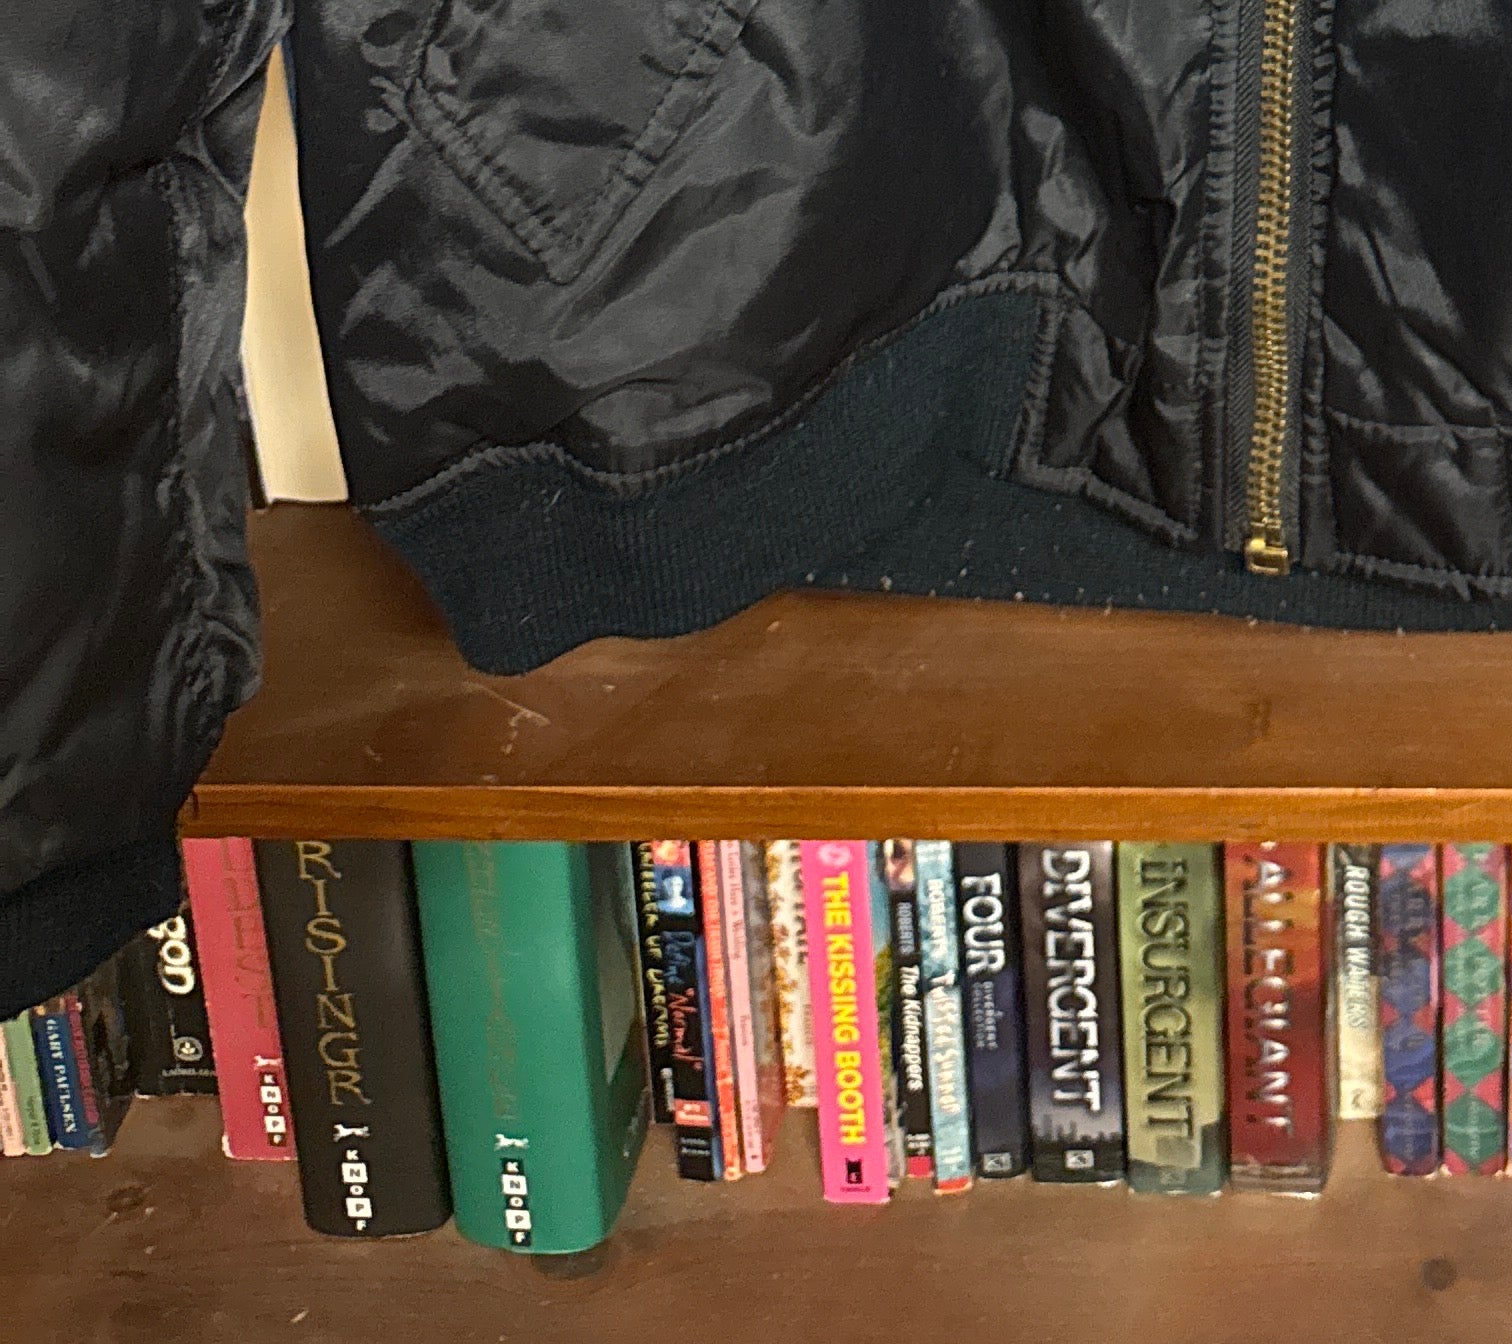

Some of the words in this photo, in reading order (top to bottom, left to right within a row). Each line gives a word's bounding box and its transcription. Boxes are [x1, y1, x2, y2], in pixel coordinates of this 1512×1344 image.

[819, 870, 853, 928] THE
[960, 872, 1006, 975] FOUR
[1344, 863, 1371, 943] ROUGH
[296, 840, 373, 1106] RISINGR
[826, 933, 860, 1044] KISSING
[900, 964, 920, 996] The
[1041, 848, 1101, 1113] DIVERGENT
[1137, 858, 1195, 1139] INSURGENT
[902, 998, 924, 1091] Kidnappers
[259, 1072, 288, 1148] KNOPF
[834, 1050, 868, 1146] BOOTH
[340, 1147, 373, 1234] KNOPF
[502, 1159, 532, 1247] KNOPF
